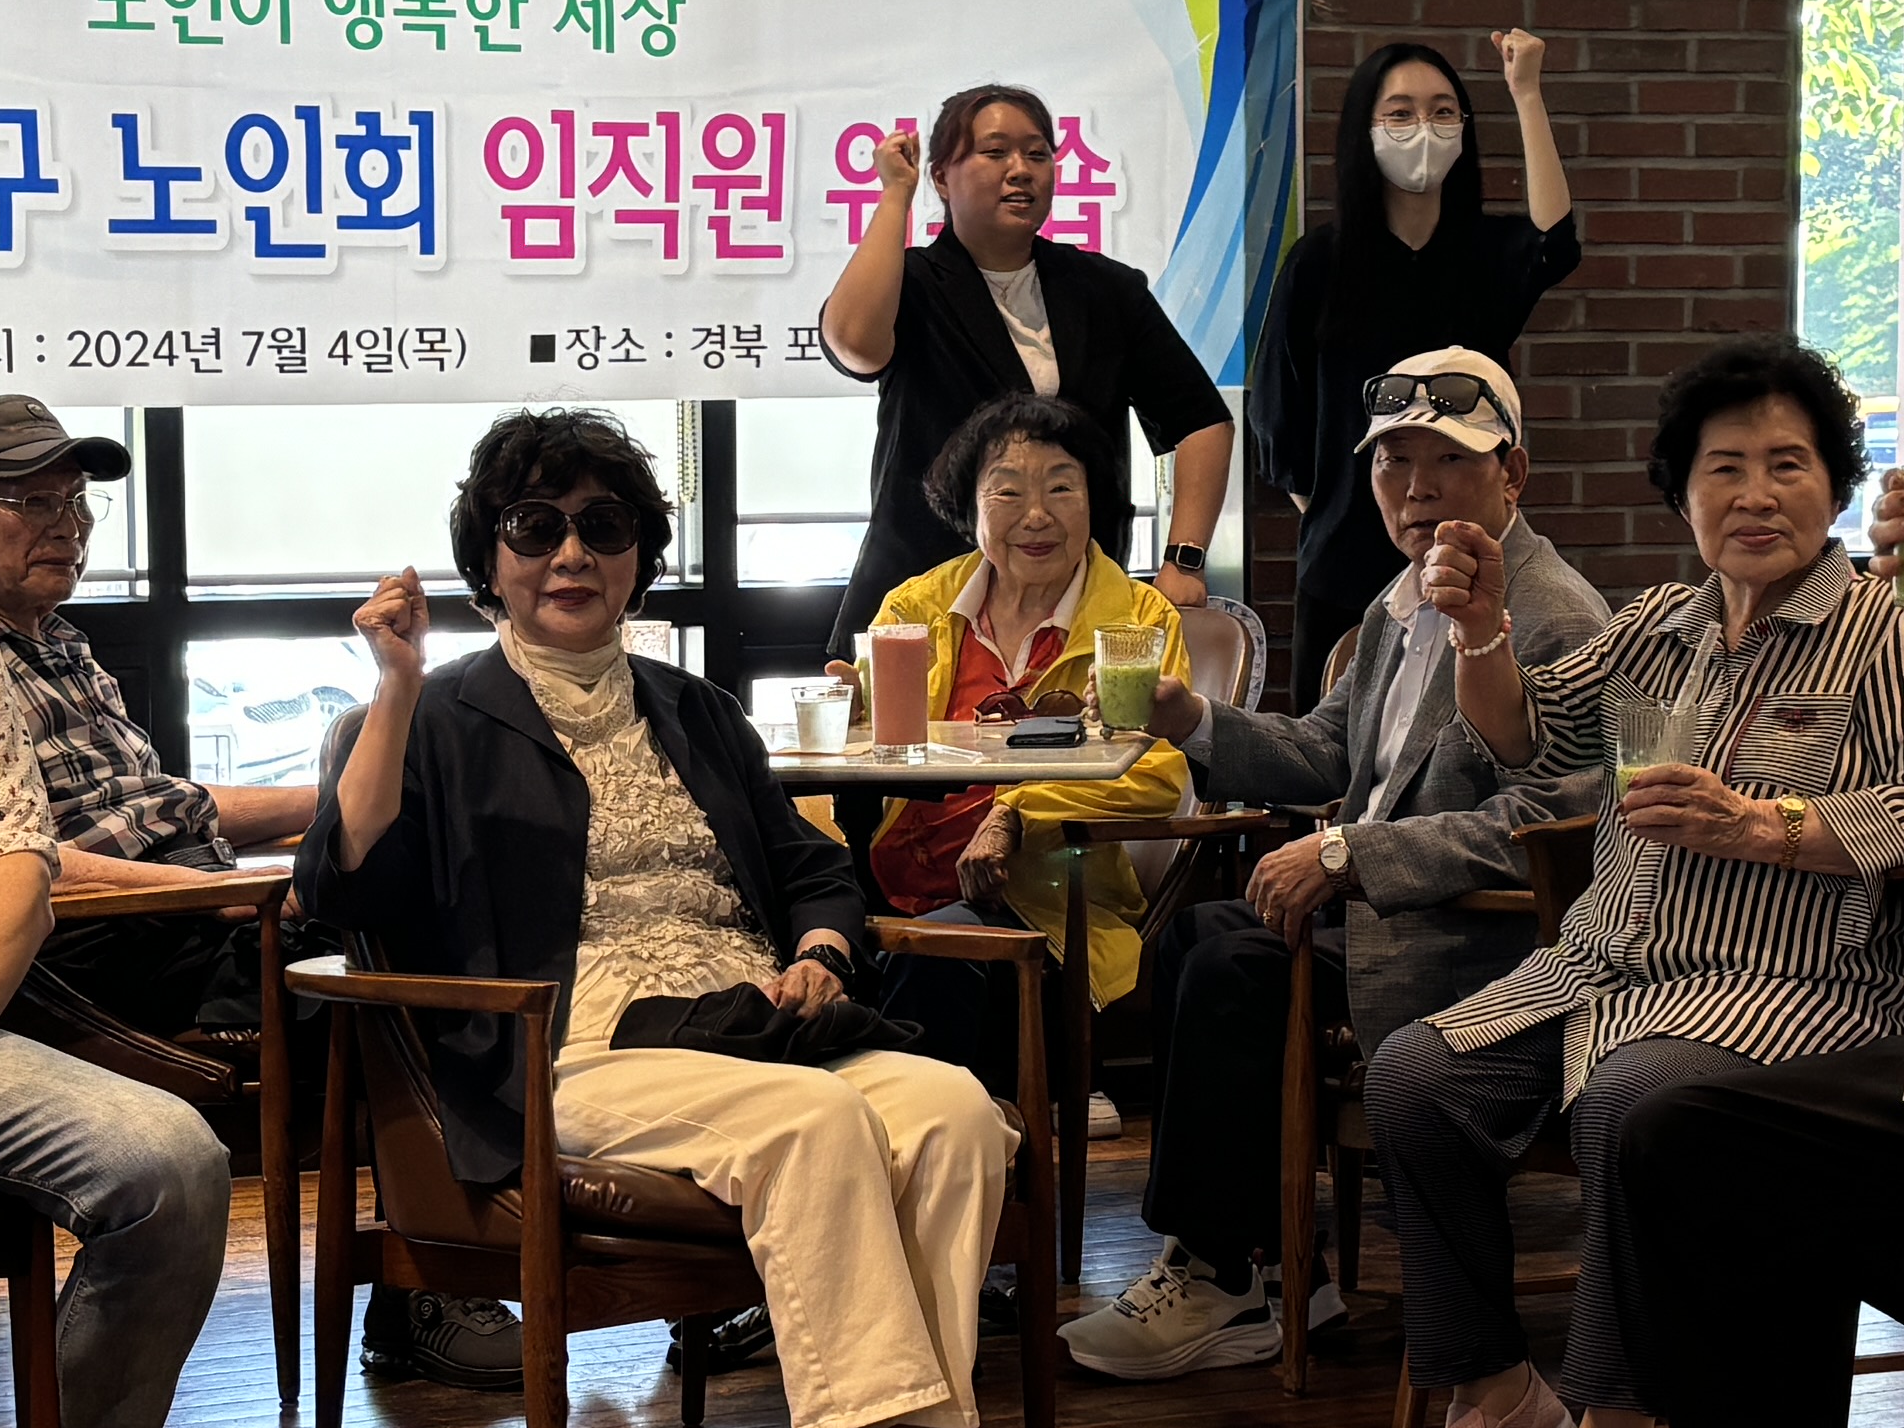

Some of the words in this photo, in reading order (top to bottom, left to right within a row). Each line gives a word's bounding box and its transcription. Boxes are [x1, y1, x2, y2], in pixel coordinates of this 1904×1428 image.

[107, 104, 435, 259] 노인회
[483, 109, 786, 261] 임직원
[825, 115, 1117, 254] 워숍
[66, 327, 223, 374] 2024년
[241, 326, 308, 374] 7월
[327, 326, 468, 374] 4일(목)
[564, 325, 648, 371] 장소
[690, 324, 769, 370] 경북
